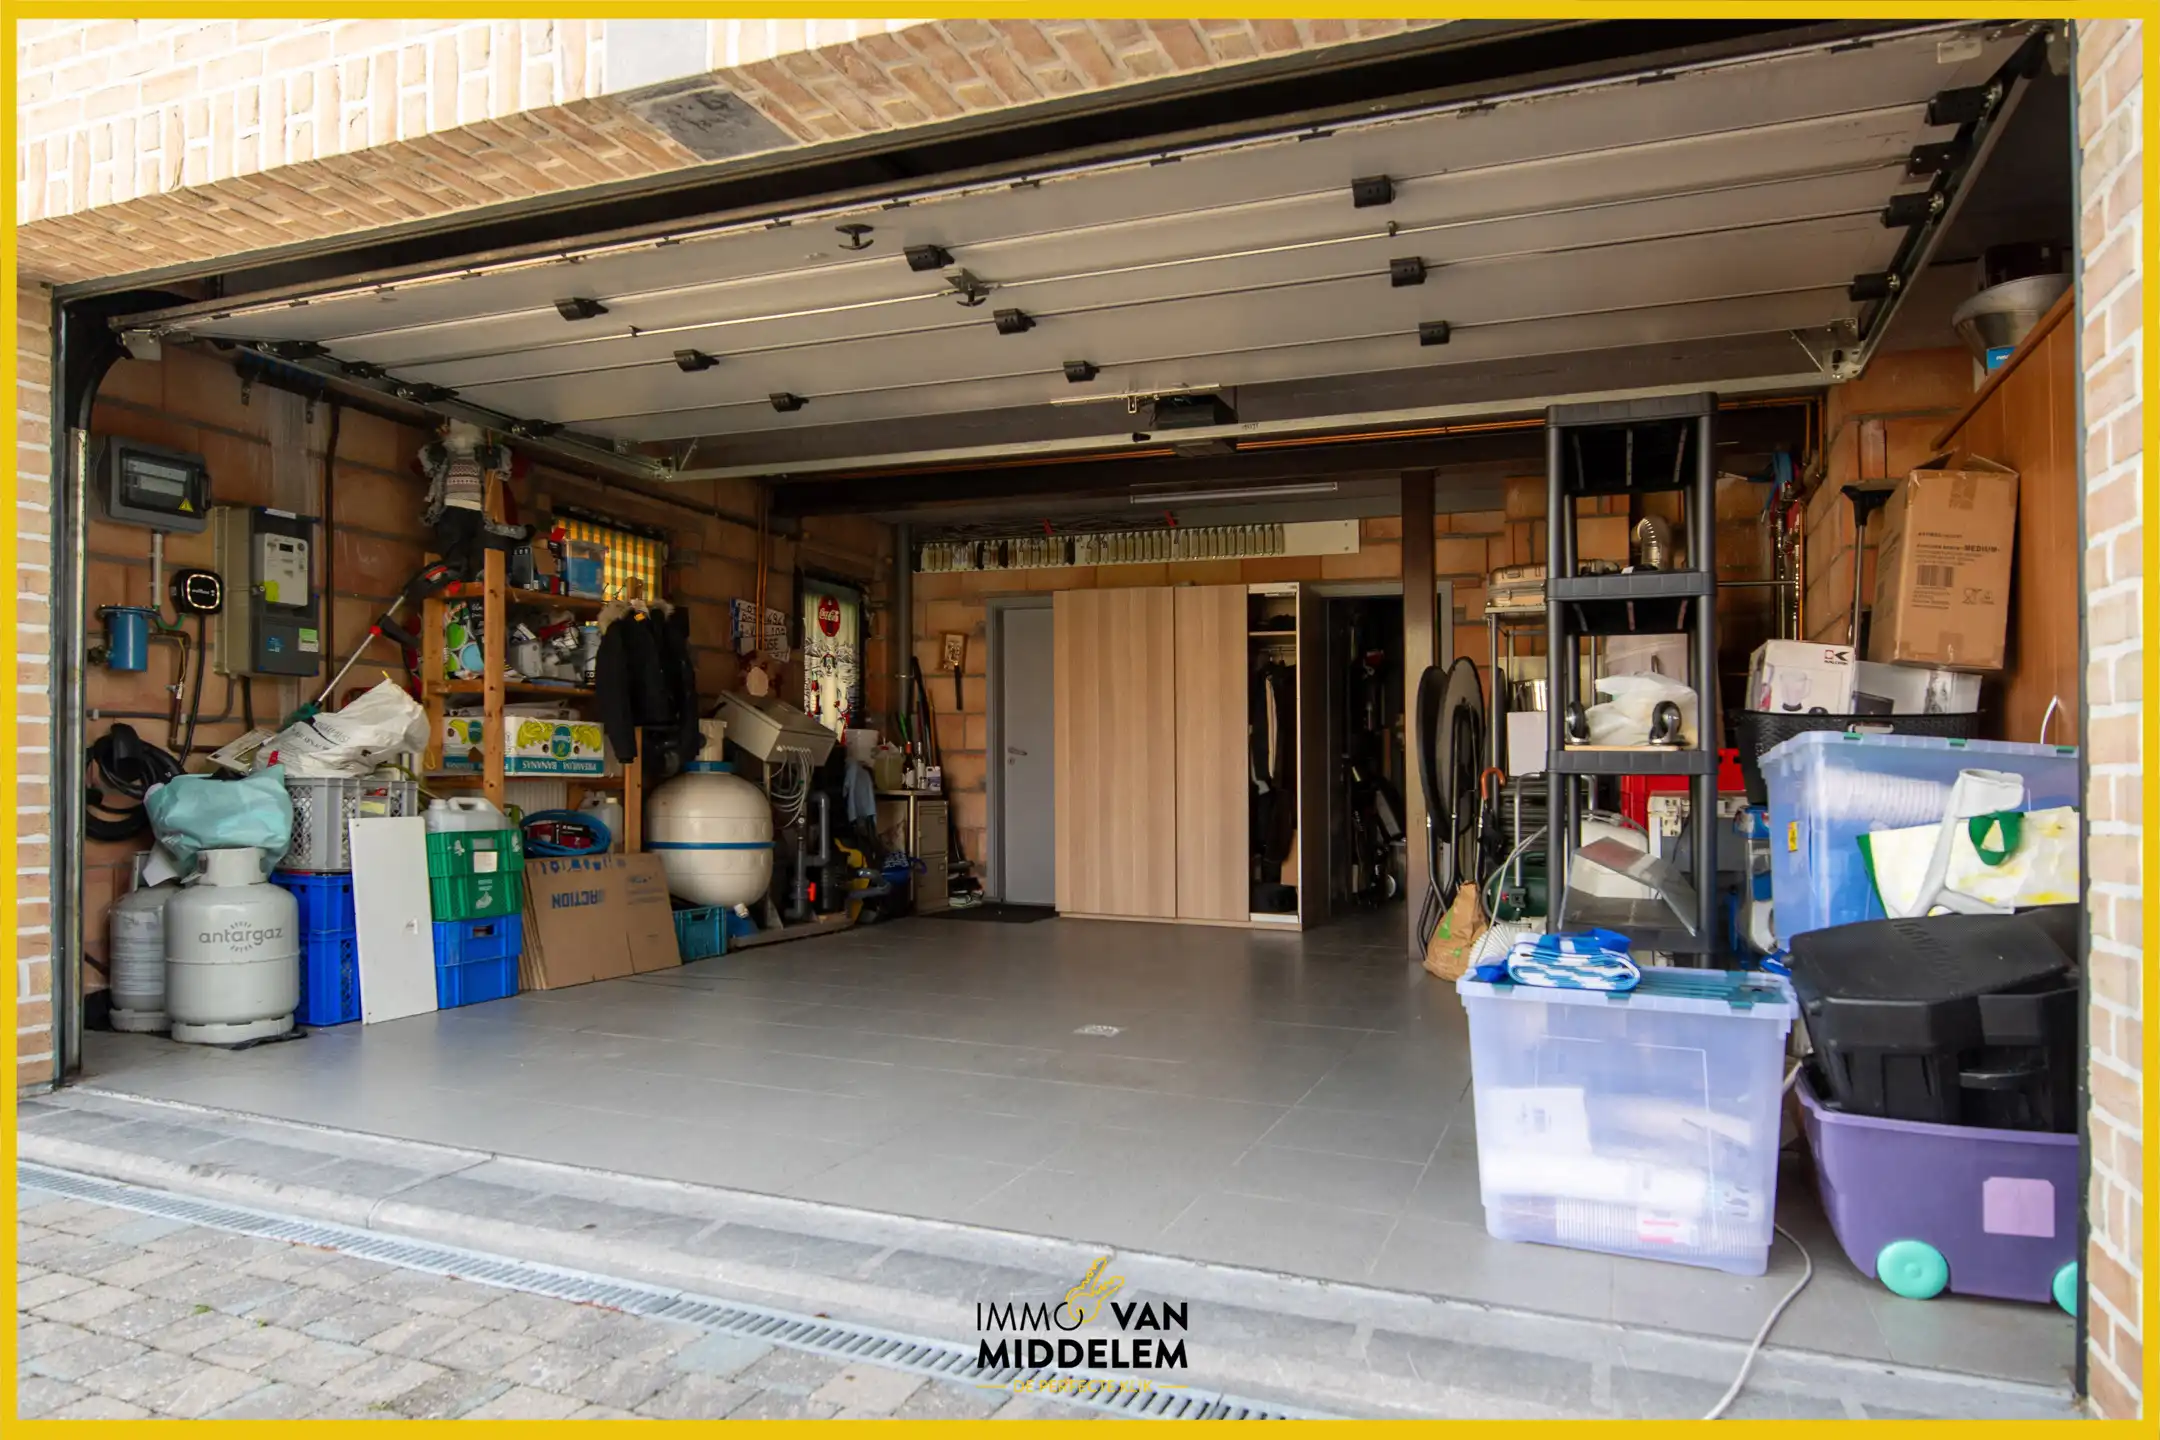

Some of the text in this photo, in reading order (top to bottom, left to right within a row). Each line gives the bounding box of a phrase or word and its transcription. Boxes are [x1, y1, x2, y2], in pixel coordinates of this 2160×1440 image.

[522, 760, 597, 771] PREMIUM BANANAS
[551, 889, 598, 909] ACTION
[198, 927, 284, 946] antargaz
